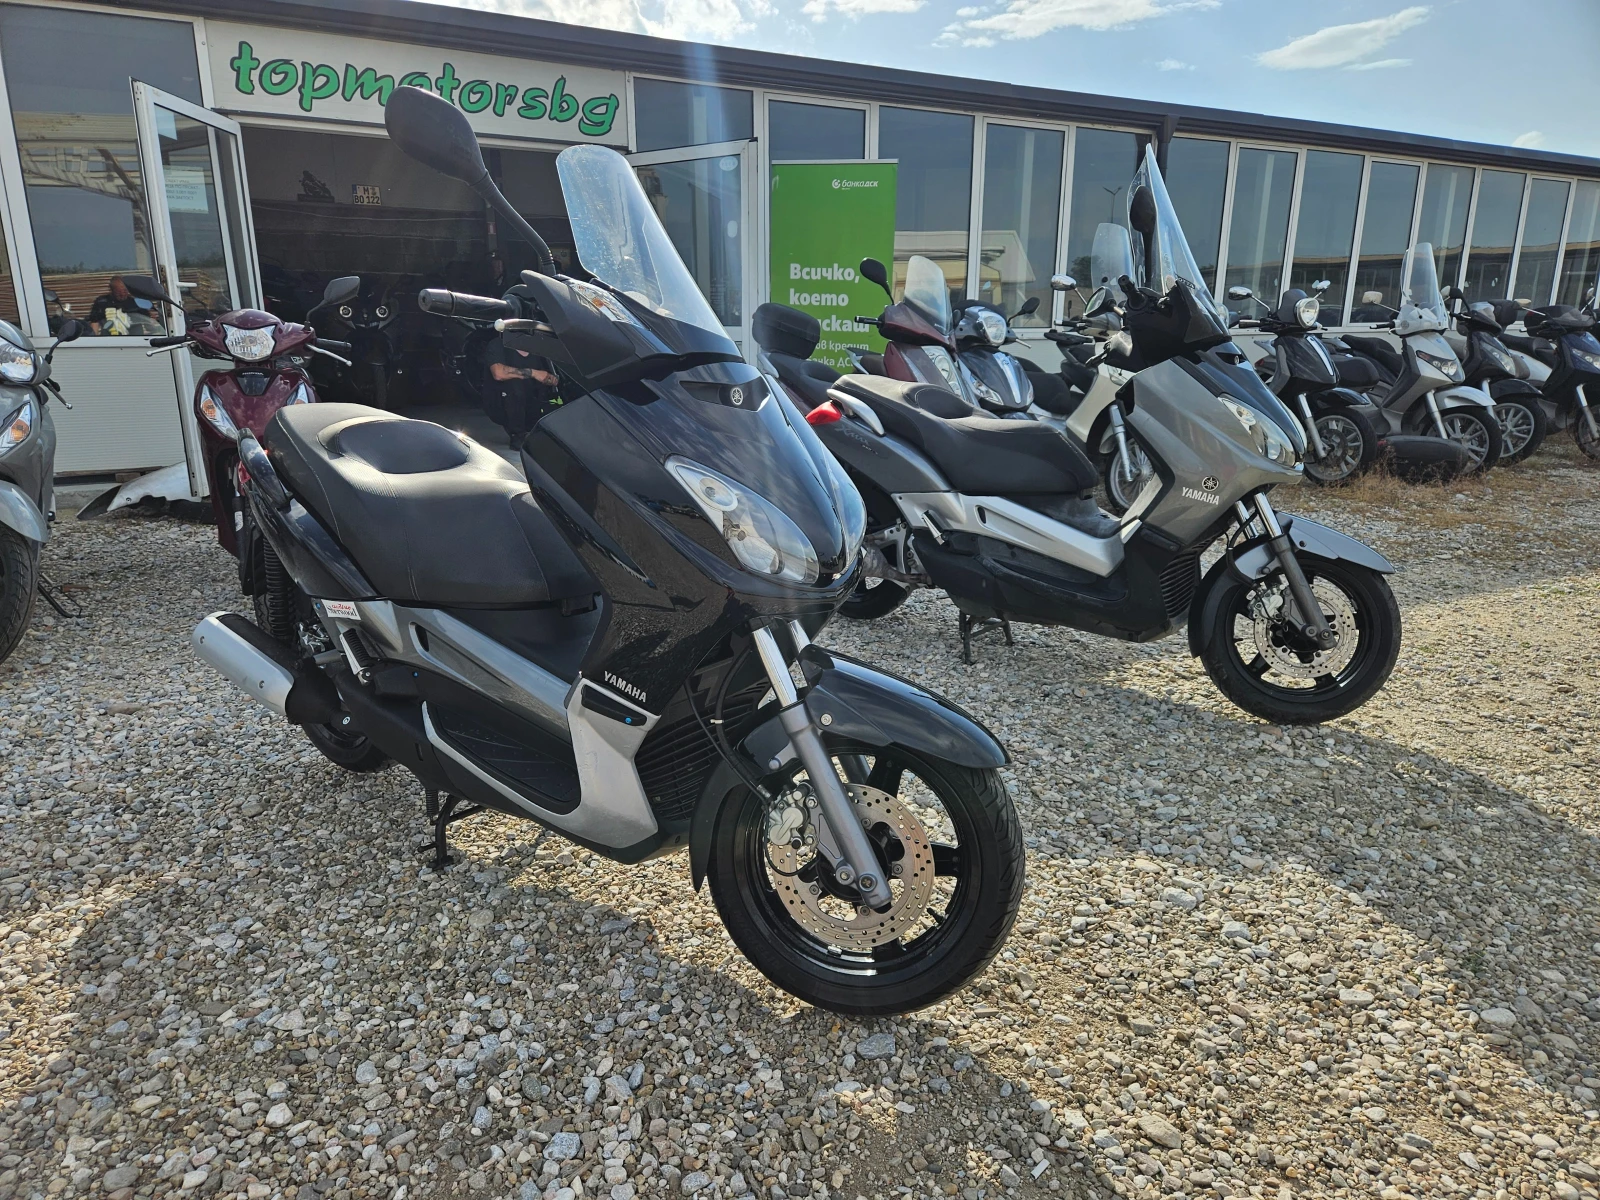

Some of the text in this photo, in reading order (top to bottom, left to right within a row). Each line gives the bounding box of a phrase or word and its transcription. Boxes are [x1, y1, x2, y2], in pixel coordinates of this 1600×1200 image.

[363, 187, 370, 195] M
[366, 196, 380, 204] 122
[789, 263, 860, 283] Всичко,
[789, 288, 849, 306] което
[818, 315, 869, 332] скаш
[837, 357, 853, 368] ДС
[1182, 487, 1219, 505] YAMAHA
[604, 670, 647, 703] YAMAHA
